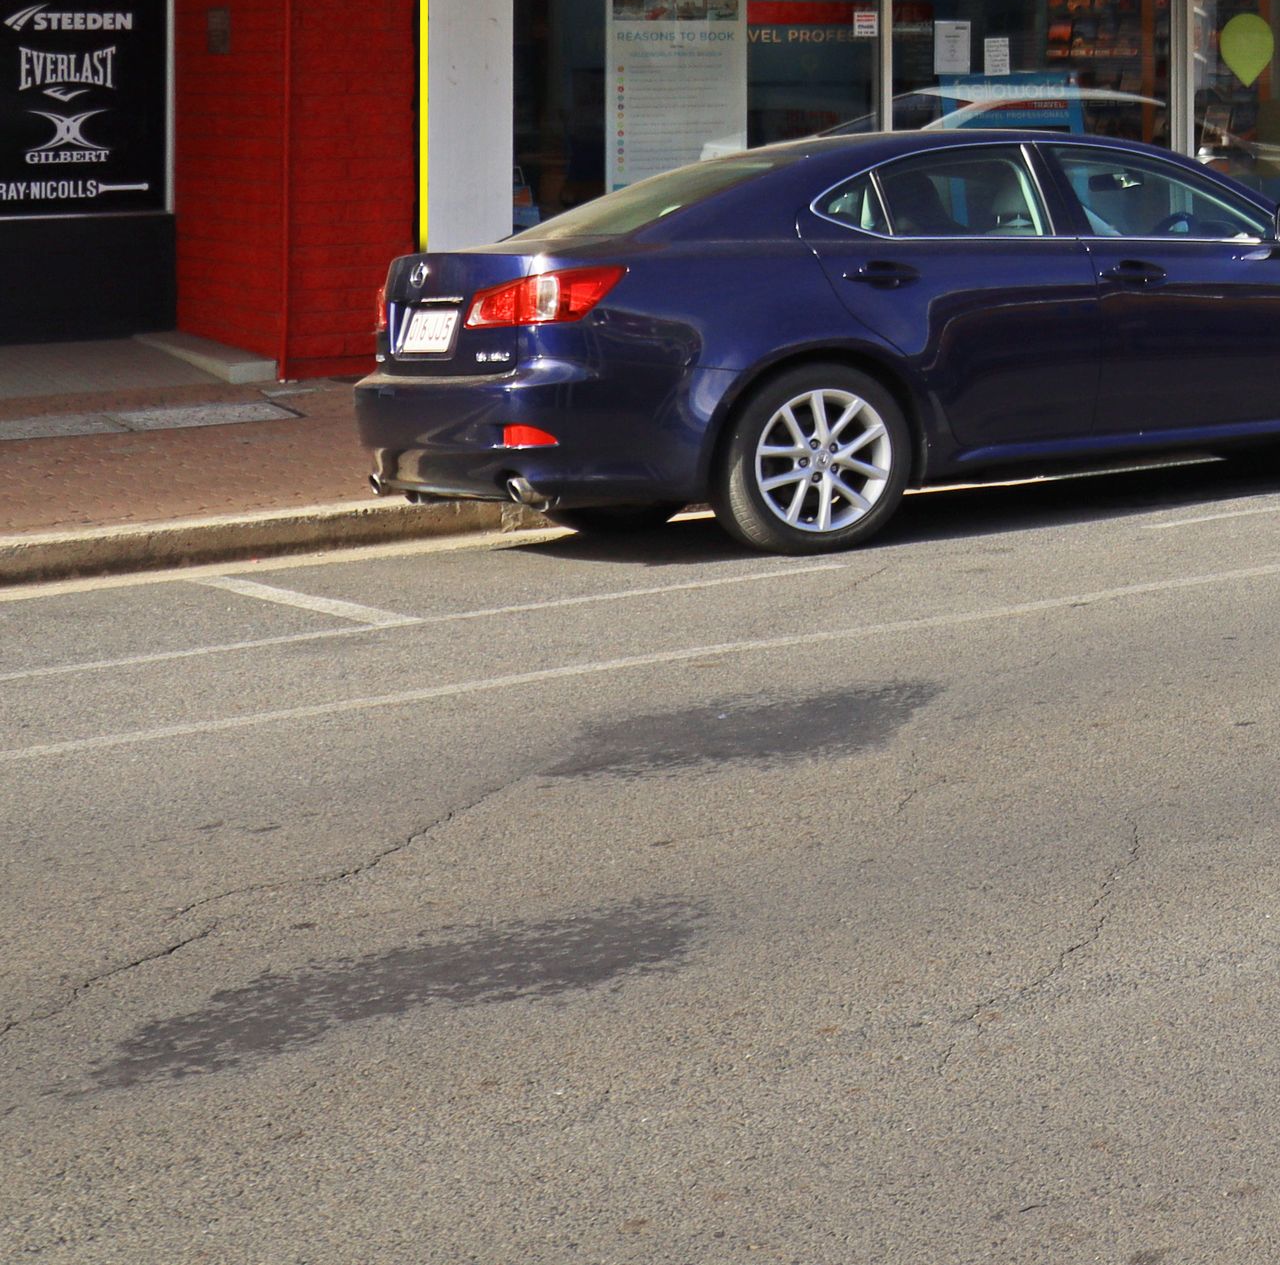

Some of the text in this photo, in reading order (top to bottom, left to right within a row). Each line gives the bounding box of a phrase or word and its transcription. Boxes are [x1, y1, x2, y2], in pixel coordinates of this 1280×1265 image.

[34, 13, 133, 31] STEEDEN
[617, 31, 735, 42] REASONS TO BOOK
[18, 45, 117, 91] EVERLAST
[25, 150, 110, 164] GILBERT
[0, 180, 97, 200] RAY-NICOLLS
